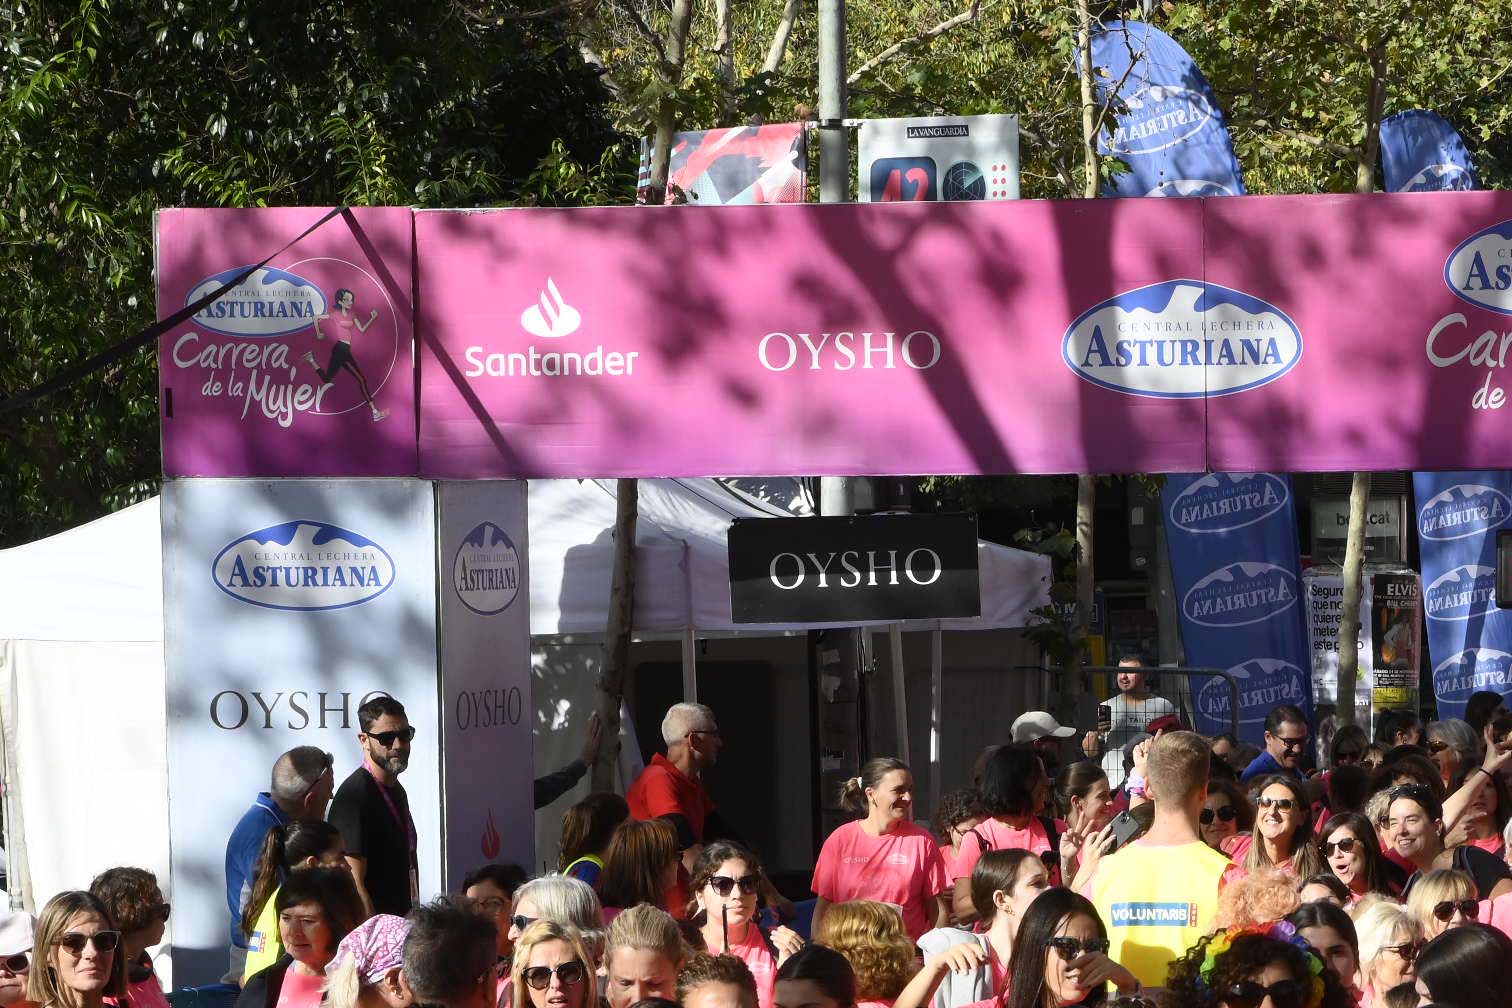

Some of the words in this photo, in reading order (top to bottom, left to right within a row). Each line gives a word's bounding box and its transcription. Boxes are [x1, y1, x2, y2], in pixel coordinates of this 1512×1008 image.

[908, 127, 920, 137] LA
[920, 125, 968, 137] VANGUARDIA
[203, 292, 315, 319] ASTURIANA
[222, 290, 262, 298] ENTRAL
[1117, 321, 1193, 333] CENTRAL
[1200, 319, 1276, 332] LECHERA
[172, 331, 288, 369] Carrera
[758, 331, 941, 371] OYSHO
[1081, 324, 1284, 368] ASTURIANA
[465, 345, 638, 378] Santander
[201, 374, 223, 396] de
[227, 374, 243, 396] la
[240, 366, 332, 427] Mujer
[1471, 372, 1508, 410] de
[253, 552, 315, 561] CENTRAL
[319, 551, 376, 560] LECHERA
[769, 548, 942, 589] OYSHO
[227, 553, 382, 588] ASTURIANA
[459, 556, 517, 591] ASTURIANA
[1388, 583, 1418, 596] ELVIS
[1312, 601, 1328, 610] que
[1313, 614, 1343, 626] quiere
[1314, 641, 1332, 650] este
[456, 686, 522, 731] OYSHO
[1111, 908, 1189, 922] VOLUNTARIS
